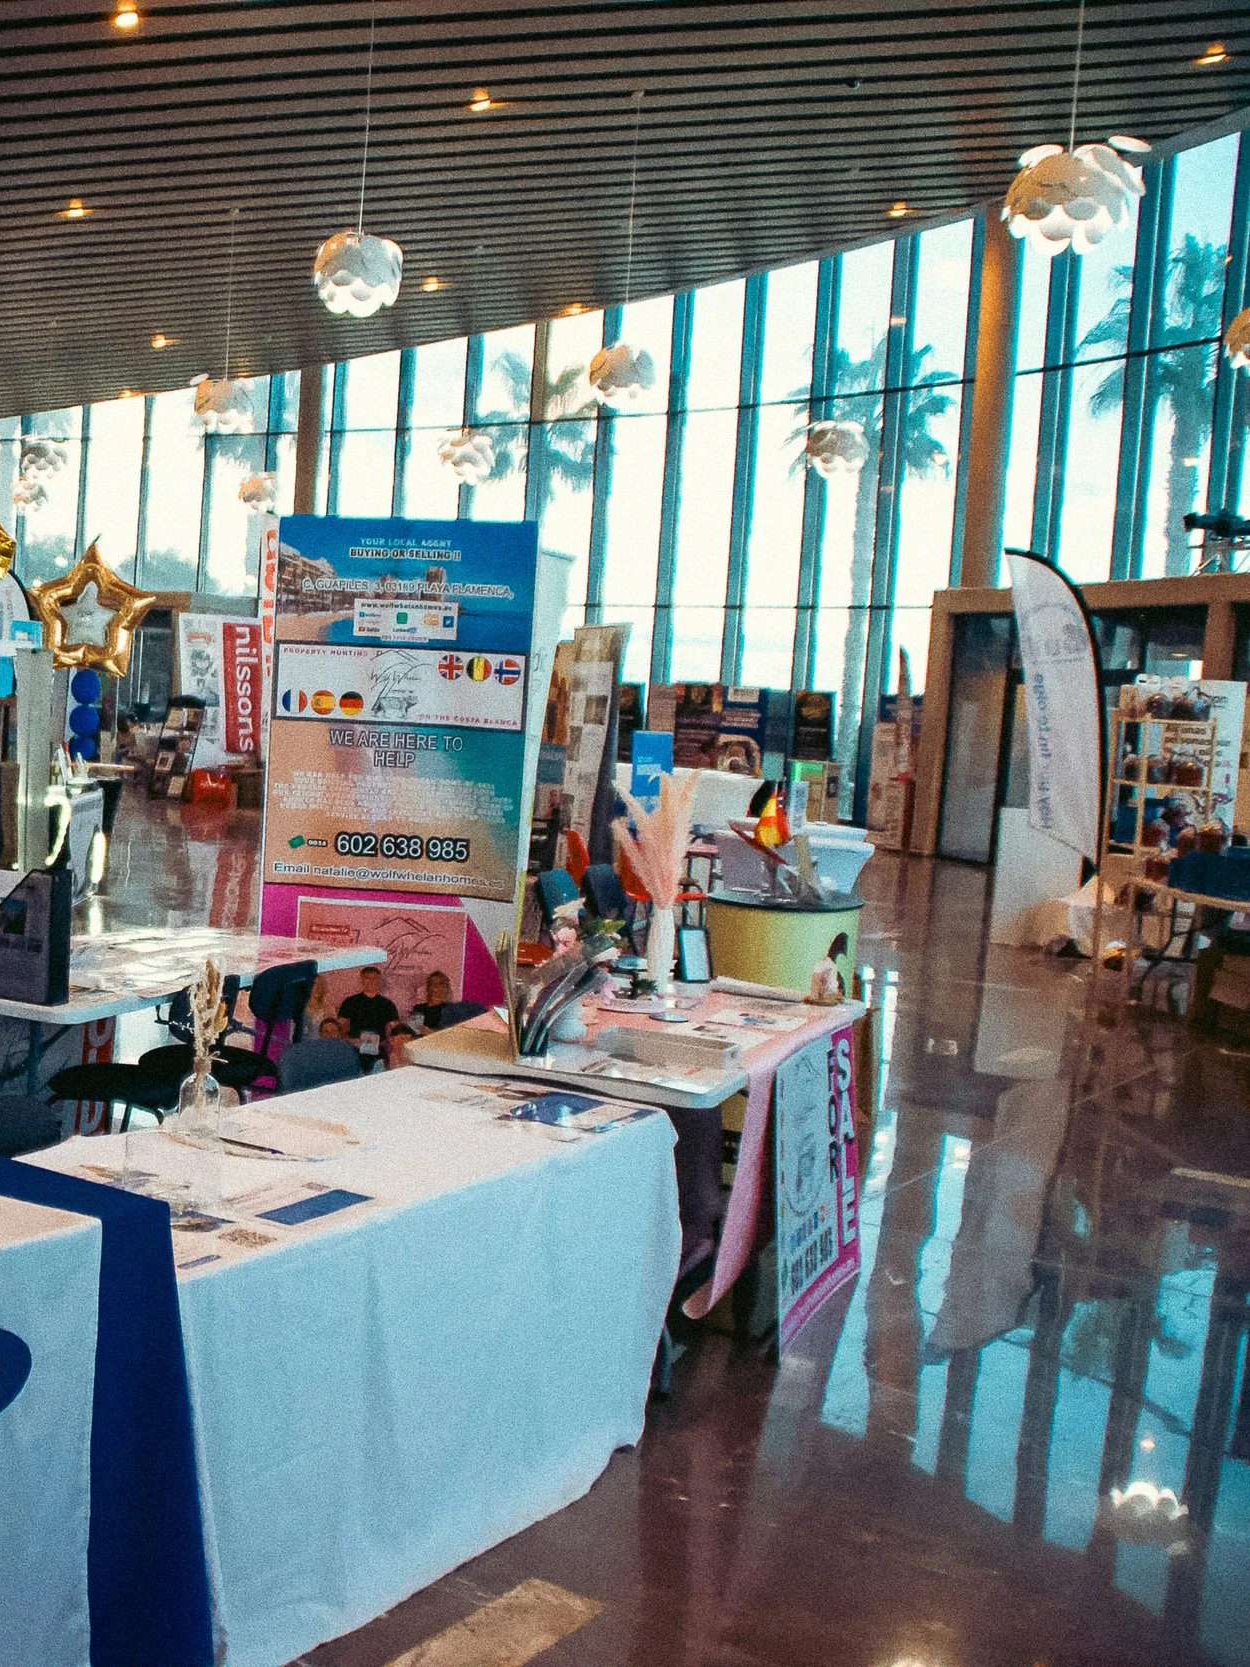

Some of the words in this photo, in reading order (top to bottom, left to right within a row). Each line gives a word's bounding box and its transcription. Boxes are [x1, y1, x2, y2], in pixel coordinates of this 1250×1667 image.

[361, 538, 385, 546] YOUR
[389, 538, 417, 547] LOCAL
[350, 548, 388, 558] BUYING
[392, 549, 405, 558] OR
[408, 549, 451, 560] SELLING
[316, 580, 368, 591] GUAPILES
[386, 581, 415, 592] 03189
[418, 583, 450, 594] PLAYA
[284, 647, 326, 655] PROPERTY
[235, 626, 259, 752] nilssons
[453, 715, 481, 724] COSTA
[483, 718, 518, 726] BLANCA
[330, 730, 353, 746] WE
[358, 730, 391, 748] ARE
[395, 732, 437, 750] HERE
[443, 735, 463, 751] TO
[374, 751, 415, 768] HELP
[336, 834, 377, 855] 602
[382, 835, 422, 858] 638
[428, 839, 468, 861] 985
[274, 862, 310, 875] Email
[313, 865, 504, 890] natalie@wolfwhelanhomes.es
[826, 1048, 840, 1184] FOR
[833, 1038, 857, 1247] SALE
